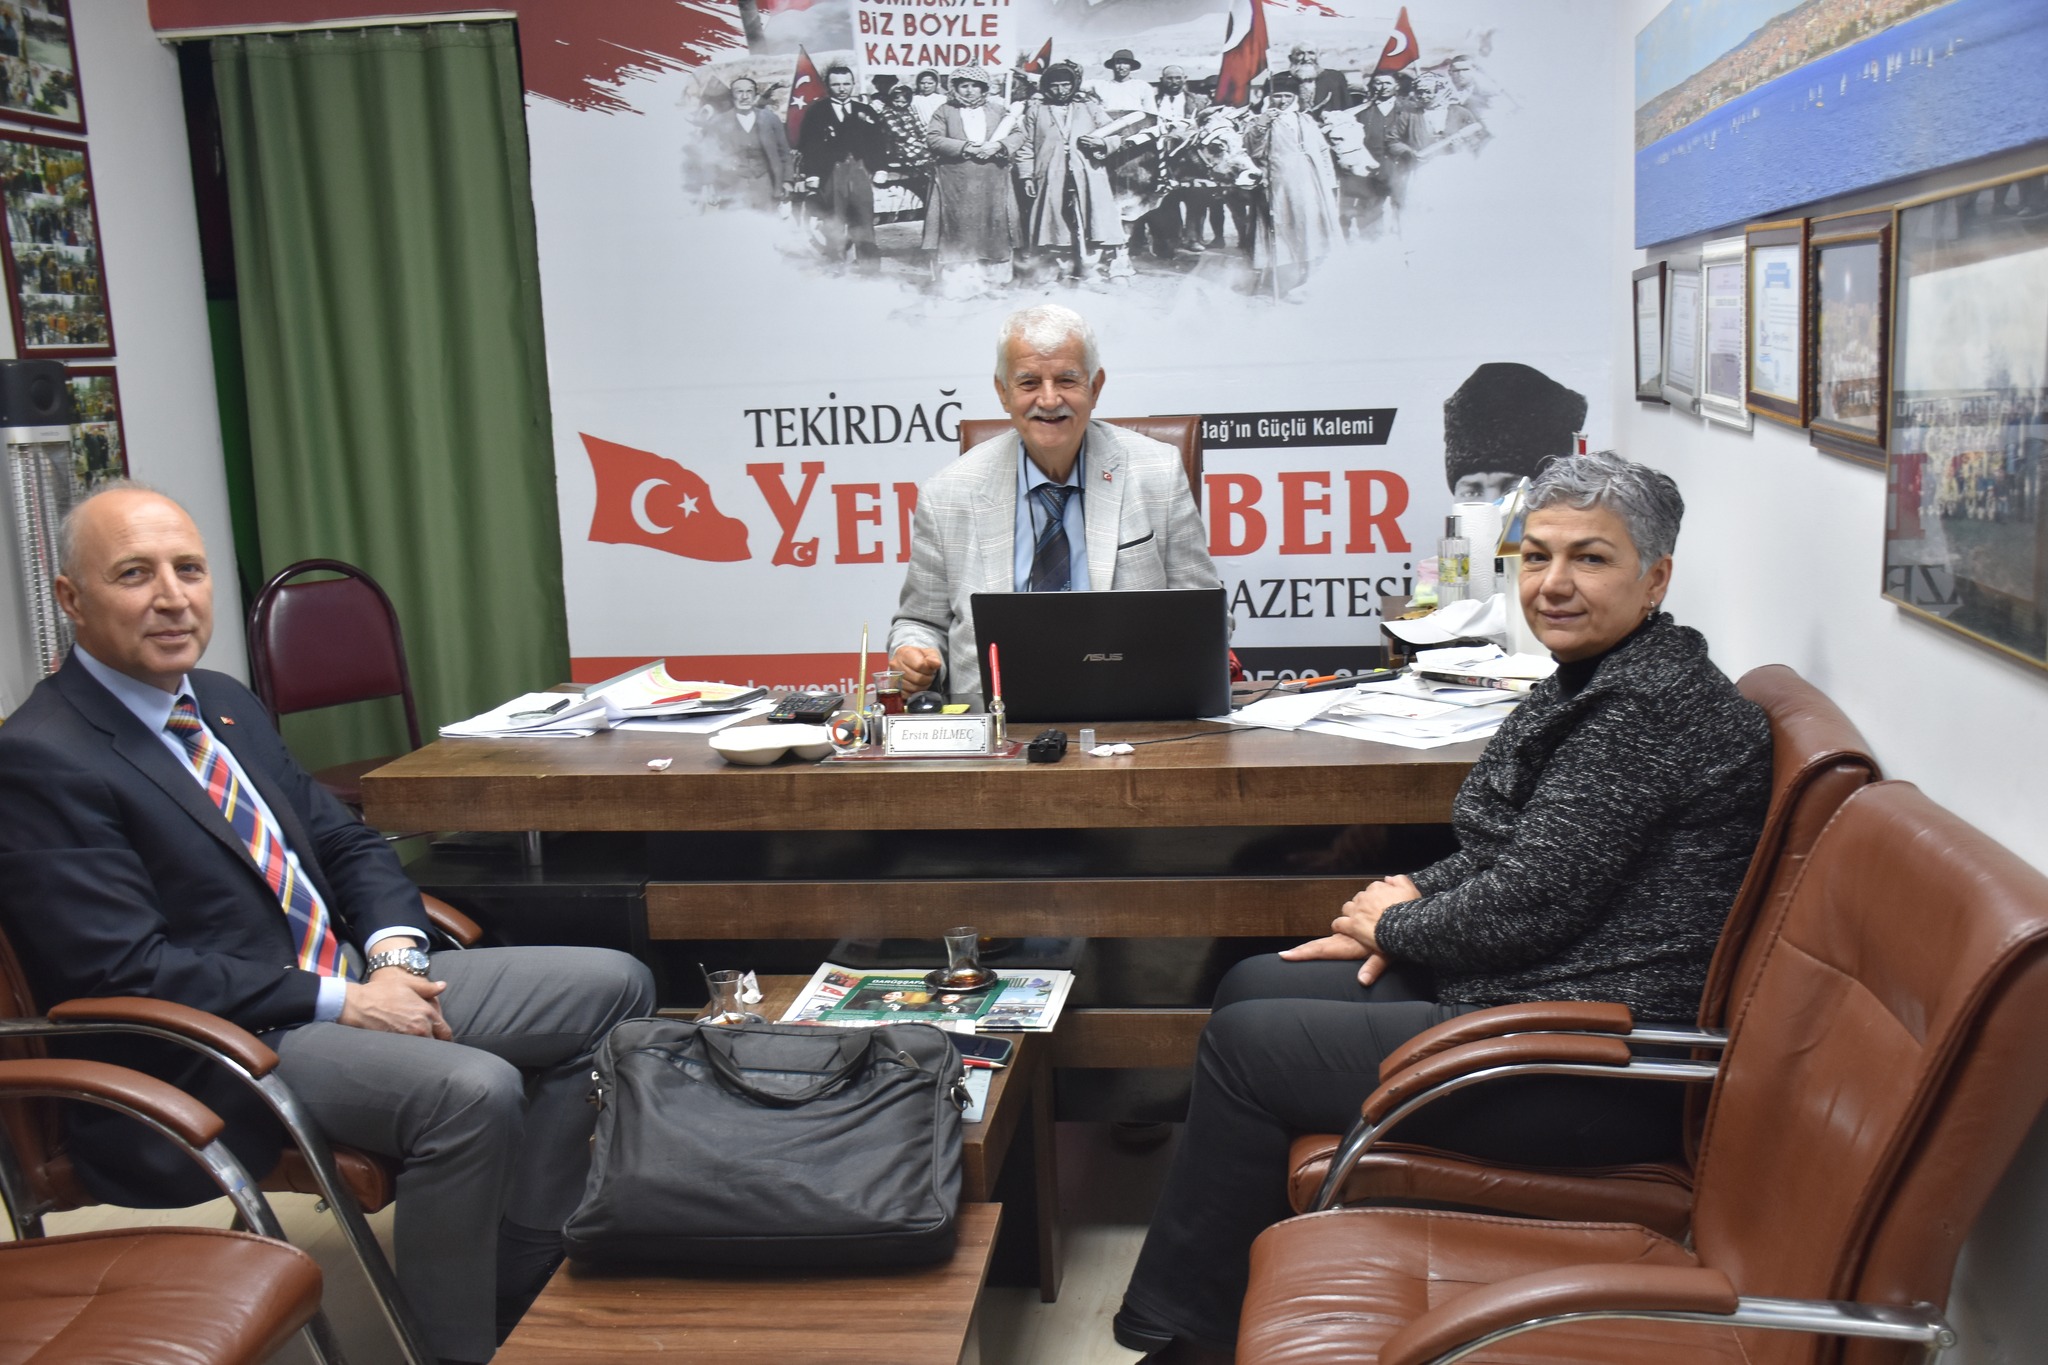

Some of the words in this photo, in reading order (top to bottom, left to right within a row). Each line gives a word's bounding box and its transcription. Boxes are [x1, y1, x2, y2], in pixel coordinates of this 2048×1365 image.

[903, 12, 998, 37] BÖYLE
[744, 388, 962, 448] TEKİRDAĞ
[1257, 418, 1307, 442] Güçlü
[1313, 416, 1373, 436] Kalemi
[1082, 652, 1123, 662] ASUS
[902, 729, 929, 741] Ersin
[932, 726, 975, 742] BİLMEÇ
